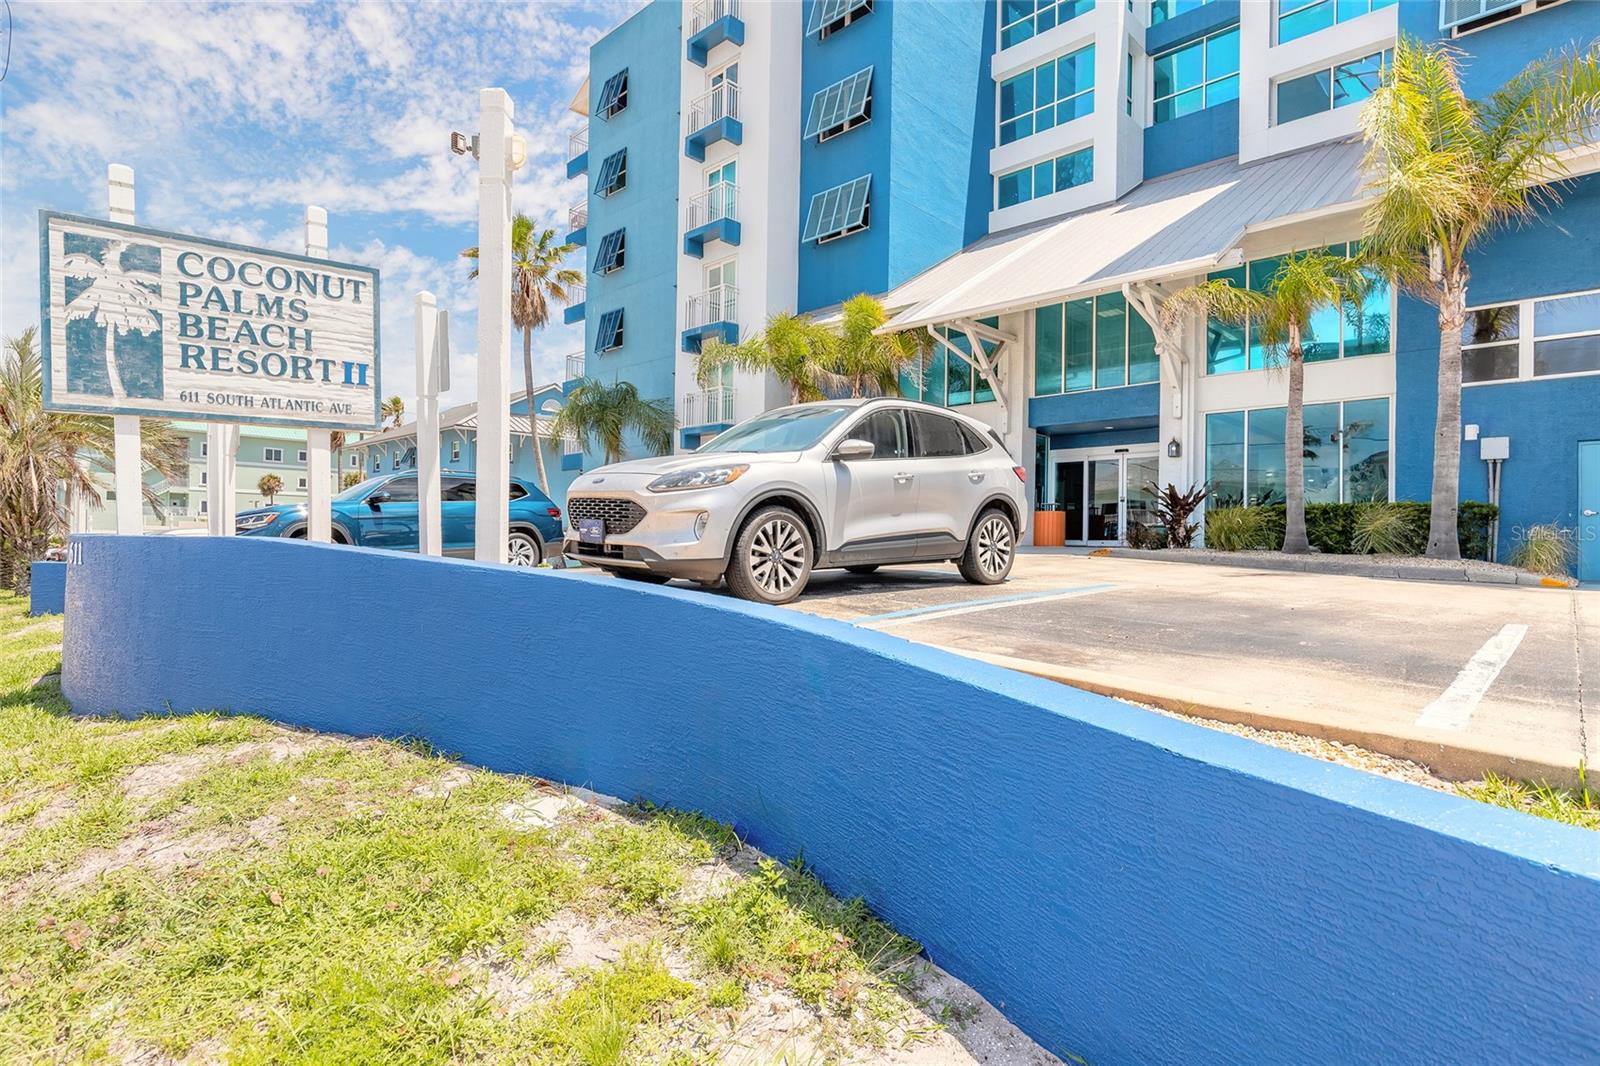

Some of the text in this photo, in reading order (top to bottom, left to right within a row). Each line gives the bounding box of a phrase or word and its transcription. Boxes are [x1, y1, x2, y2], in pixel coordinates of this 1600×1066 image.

[177, 252, 366, 303] COCONUT
[178, 281, 308, 322] PALMS
[178, 312, 313, 351] BEACH
[179, 343, 369, 386] RESORT II
[180, 391, 356, 415] 611 SOUTH ATLANTIC AVE.
